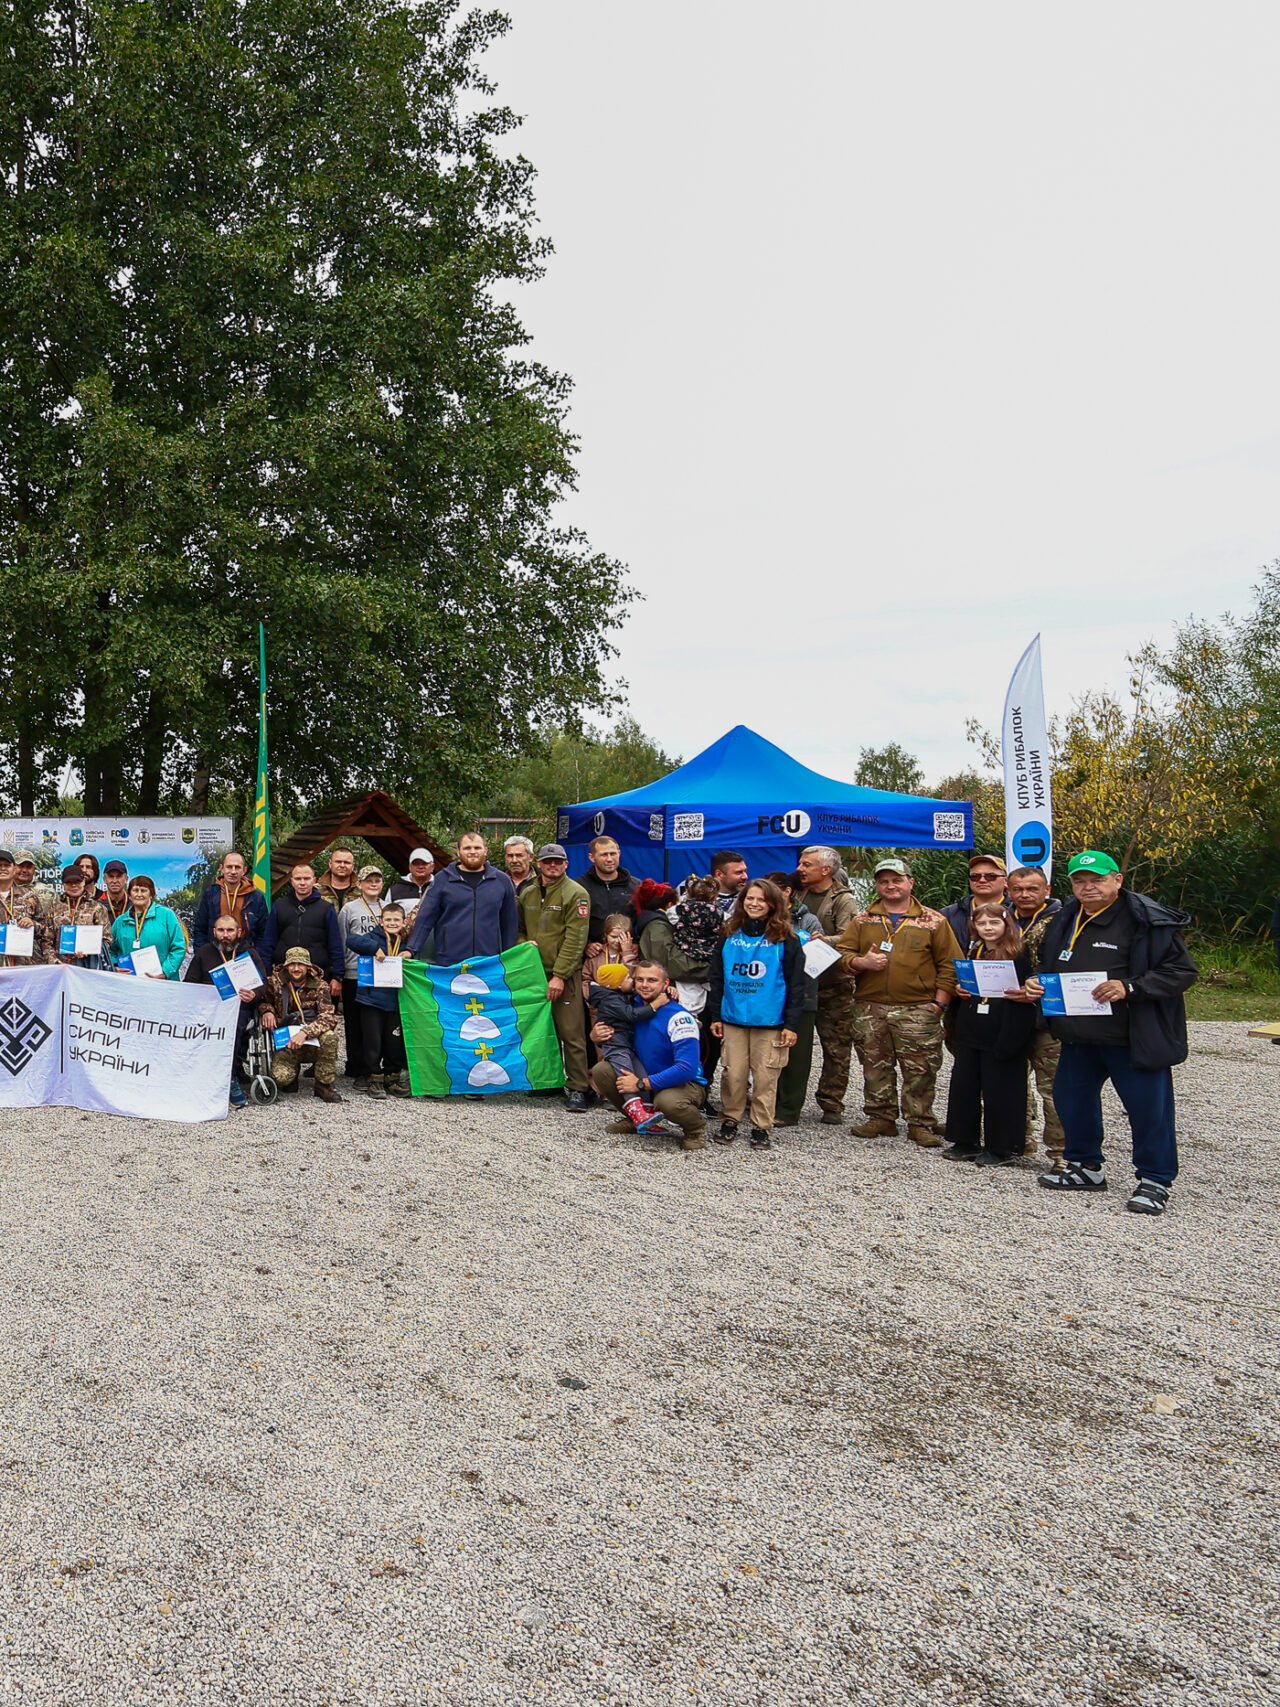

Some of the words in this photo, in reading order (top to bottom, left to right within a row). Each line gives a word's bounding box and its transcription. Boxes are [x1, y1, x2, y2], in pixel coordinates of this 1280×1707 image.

[1012, 706, 1028, 774] РИБАЛОК
[1015, 774, 1030, 810] КЛУБ
[1029, 750, 1046, 809] УКРАЇНИ
[757, 812, 803, 834] FCU
[817, 814, 839, 823] КЛУБ
[840, 814, 880, 825] РИБАЛОК
[817, 823, 853, 834] УКРАЇНИ
[731, 962, 760, 977] FCU
[69, 1002, 226, 1041] РЕАБІЛІТАЦІЙНІ
[674, 1016, 692, 1027] FCU
[69, 1045, 150, 1077] УКРАЇНИ
